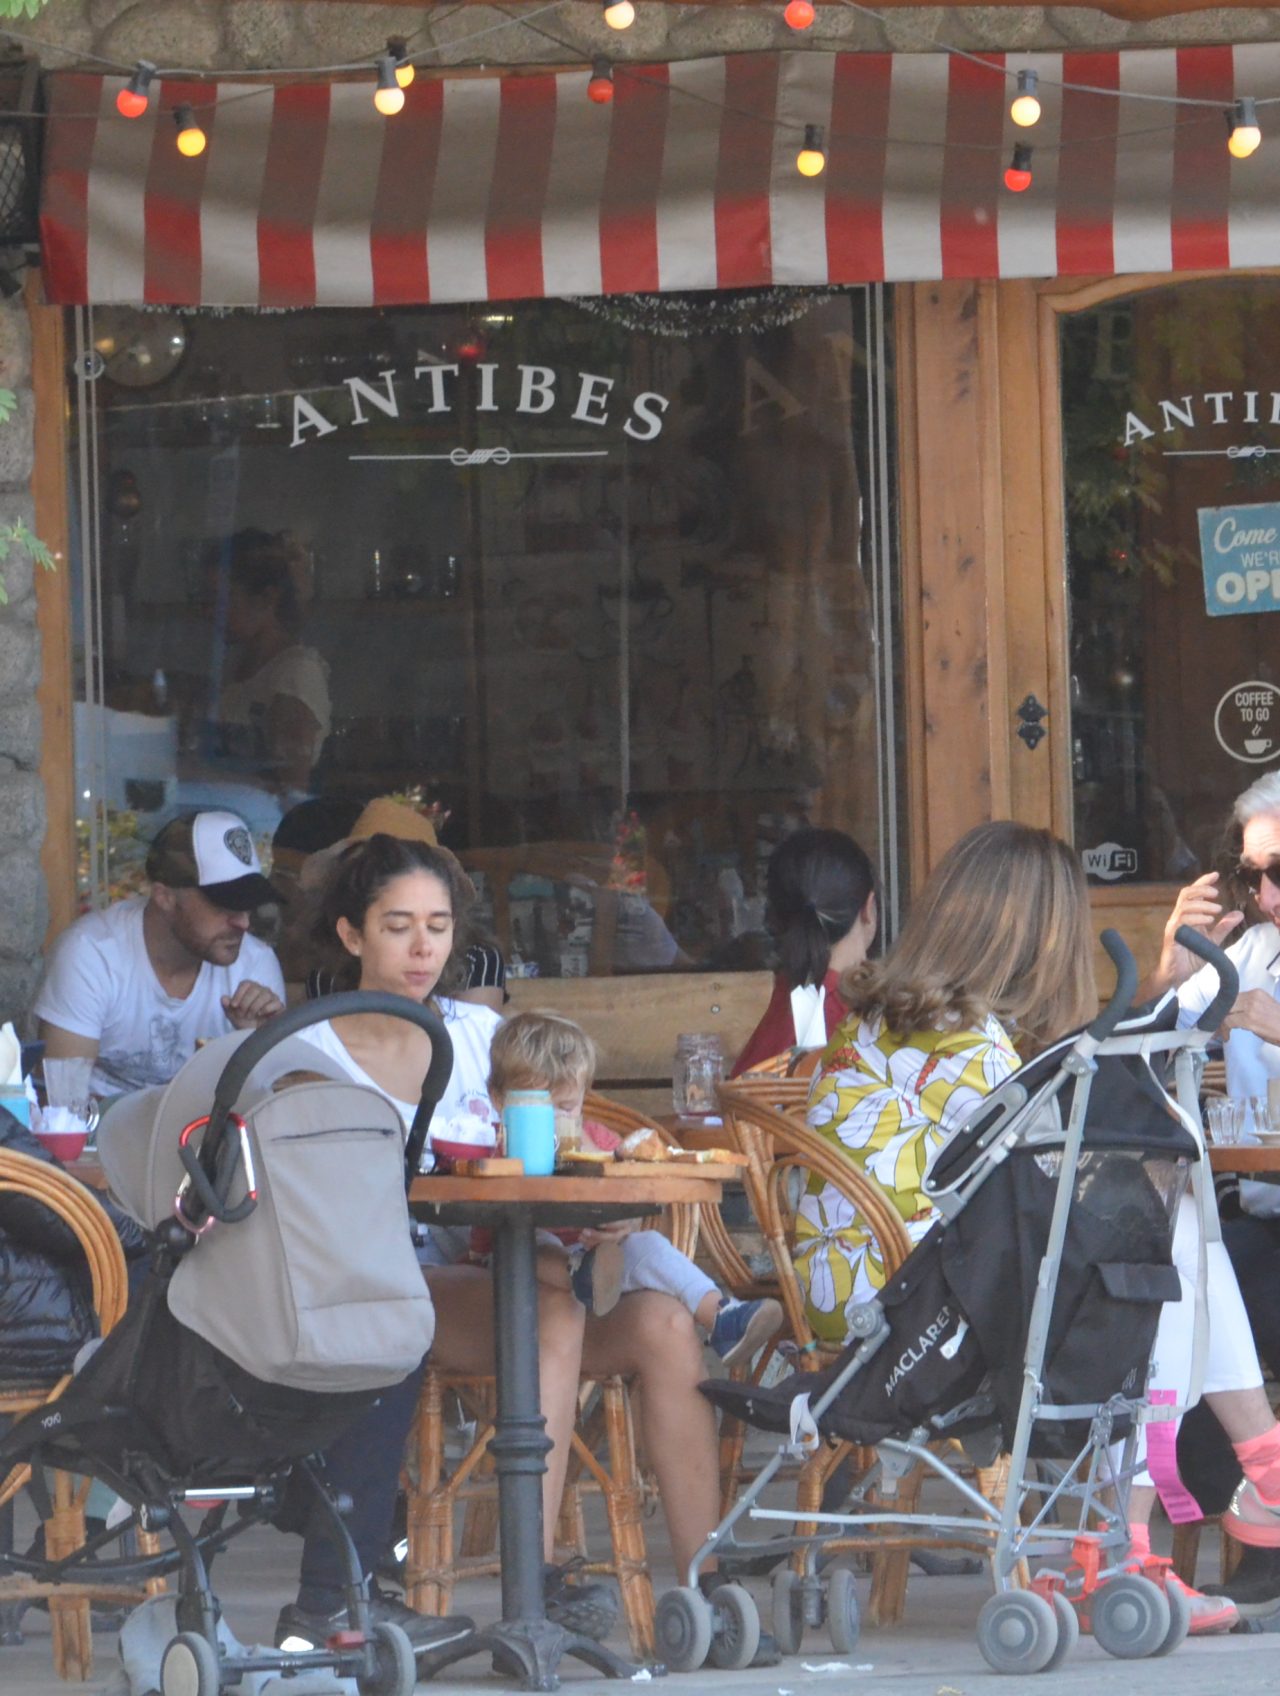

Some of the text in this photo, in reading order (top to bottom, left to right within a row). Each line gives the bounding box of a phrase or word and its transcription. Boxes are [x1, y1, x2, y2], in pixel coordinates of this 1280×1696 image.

[289, 363, 669, 448] ANTIBES
[1214, 517, 1277, 554] Come
[1235, 691, 1274, 707] COFFEE
[1240, 707, 1270, 722] TO GO
